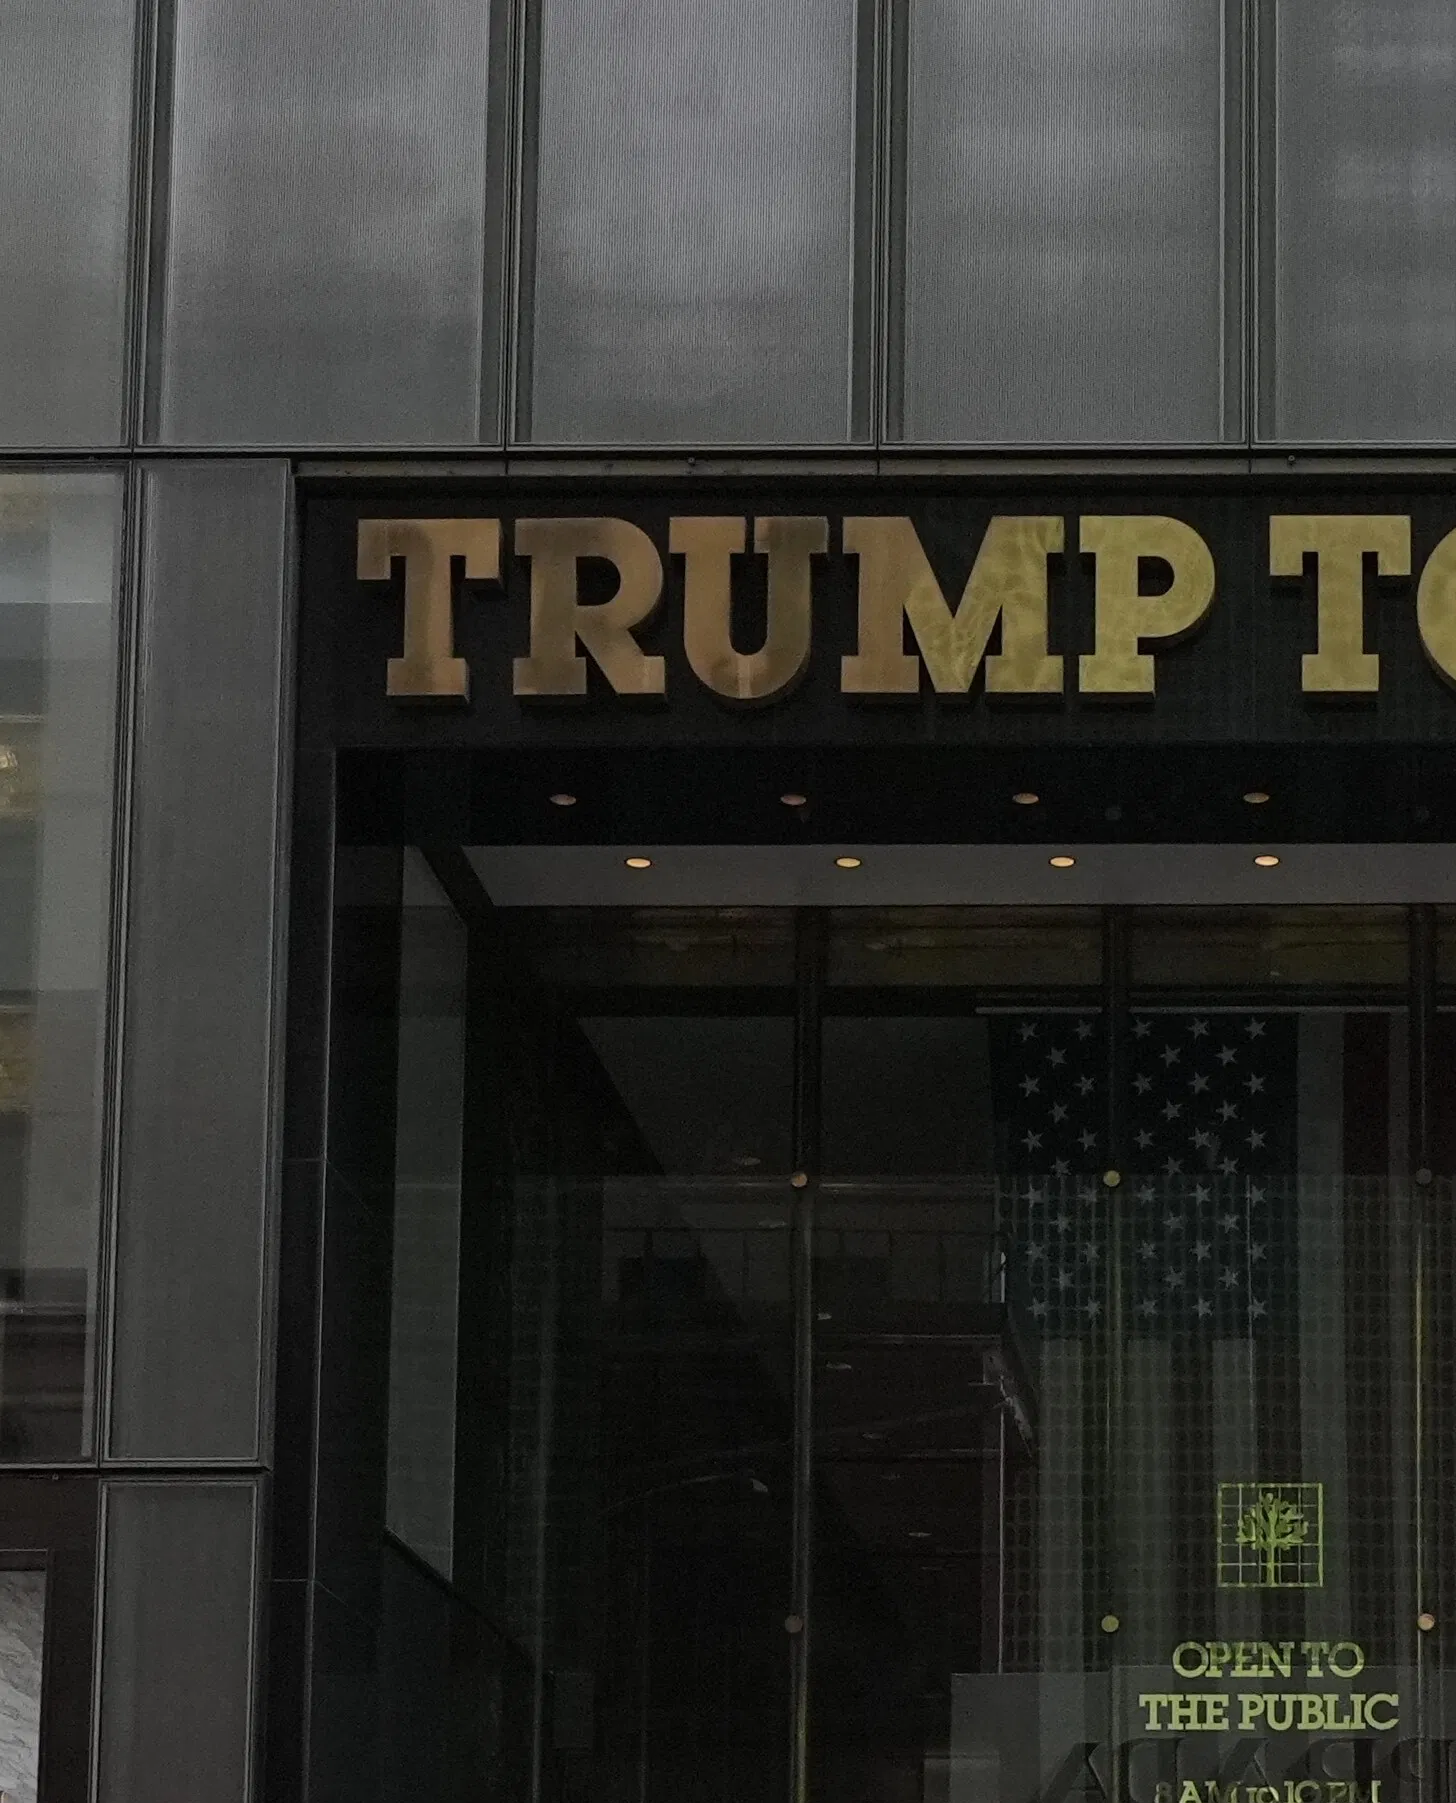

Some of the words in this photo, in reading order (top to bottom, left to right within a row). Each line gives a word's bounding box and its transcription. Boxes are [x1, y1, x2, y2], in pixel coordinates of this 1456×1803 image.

[356, 514, 1216, 706] TRUMP
[1171, 1640, 1296, 1679] OPEN
[1300, 1640, 1366, 1679] TO
[1139, 1693, 1230, 1731] THE
[1236, 1693, 1401, 1731] PUBLIC
